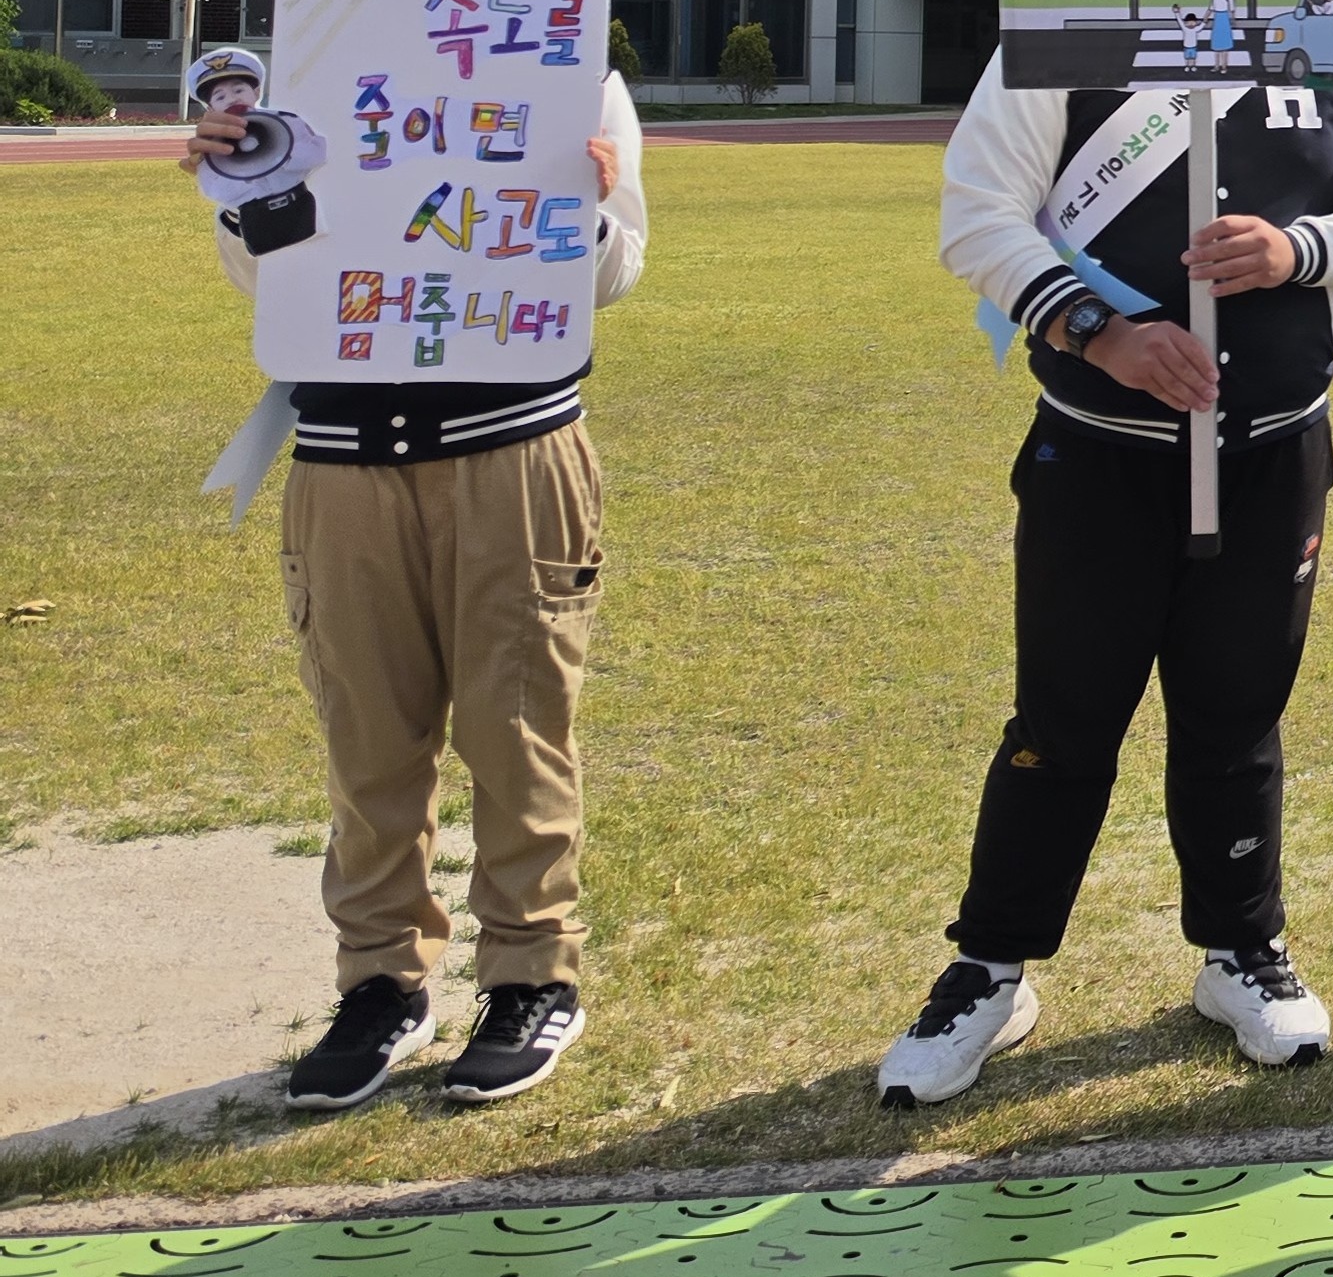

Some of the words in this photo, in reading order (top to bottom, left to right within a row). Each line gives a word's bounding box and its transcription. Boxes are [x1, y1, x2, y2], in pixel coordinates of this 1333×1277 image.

[353, 74, 529, 171] 줄이면
[1096, 113, 1170, 186] 안전은
[404, 182, 588, 263] 사고도
[1058, 181, 1099, 230] 기본
[338, 270, 569, 368] 멈춥니다!
